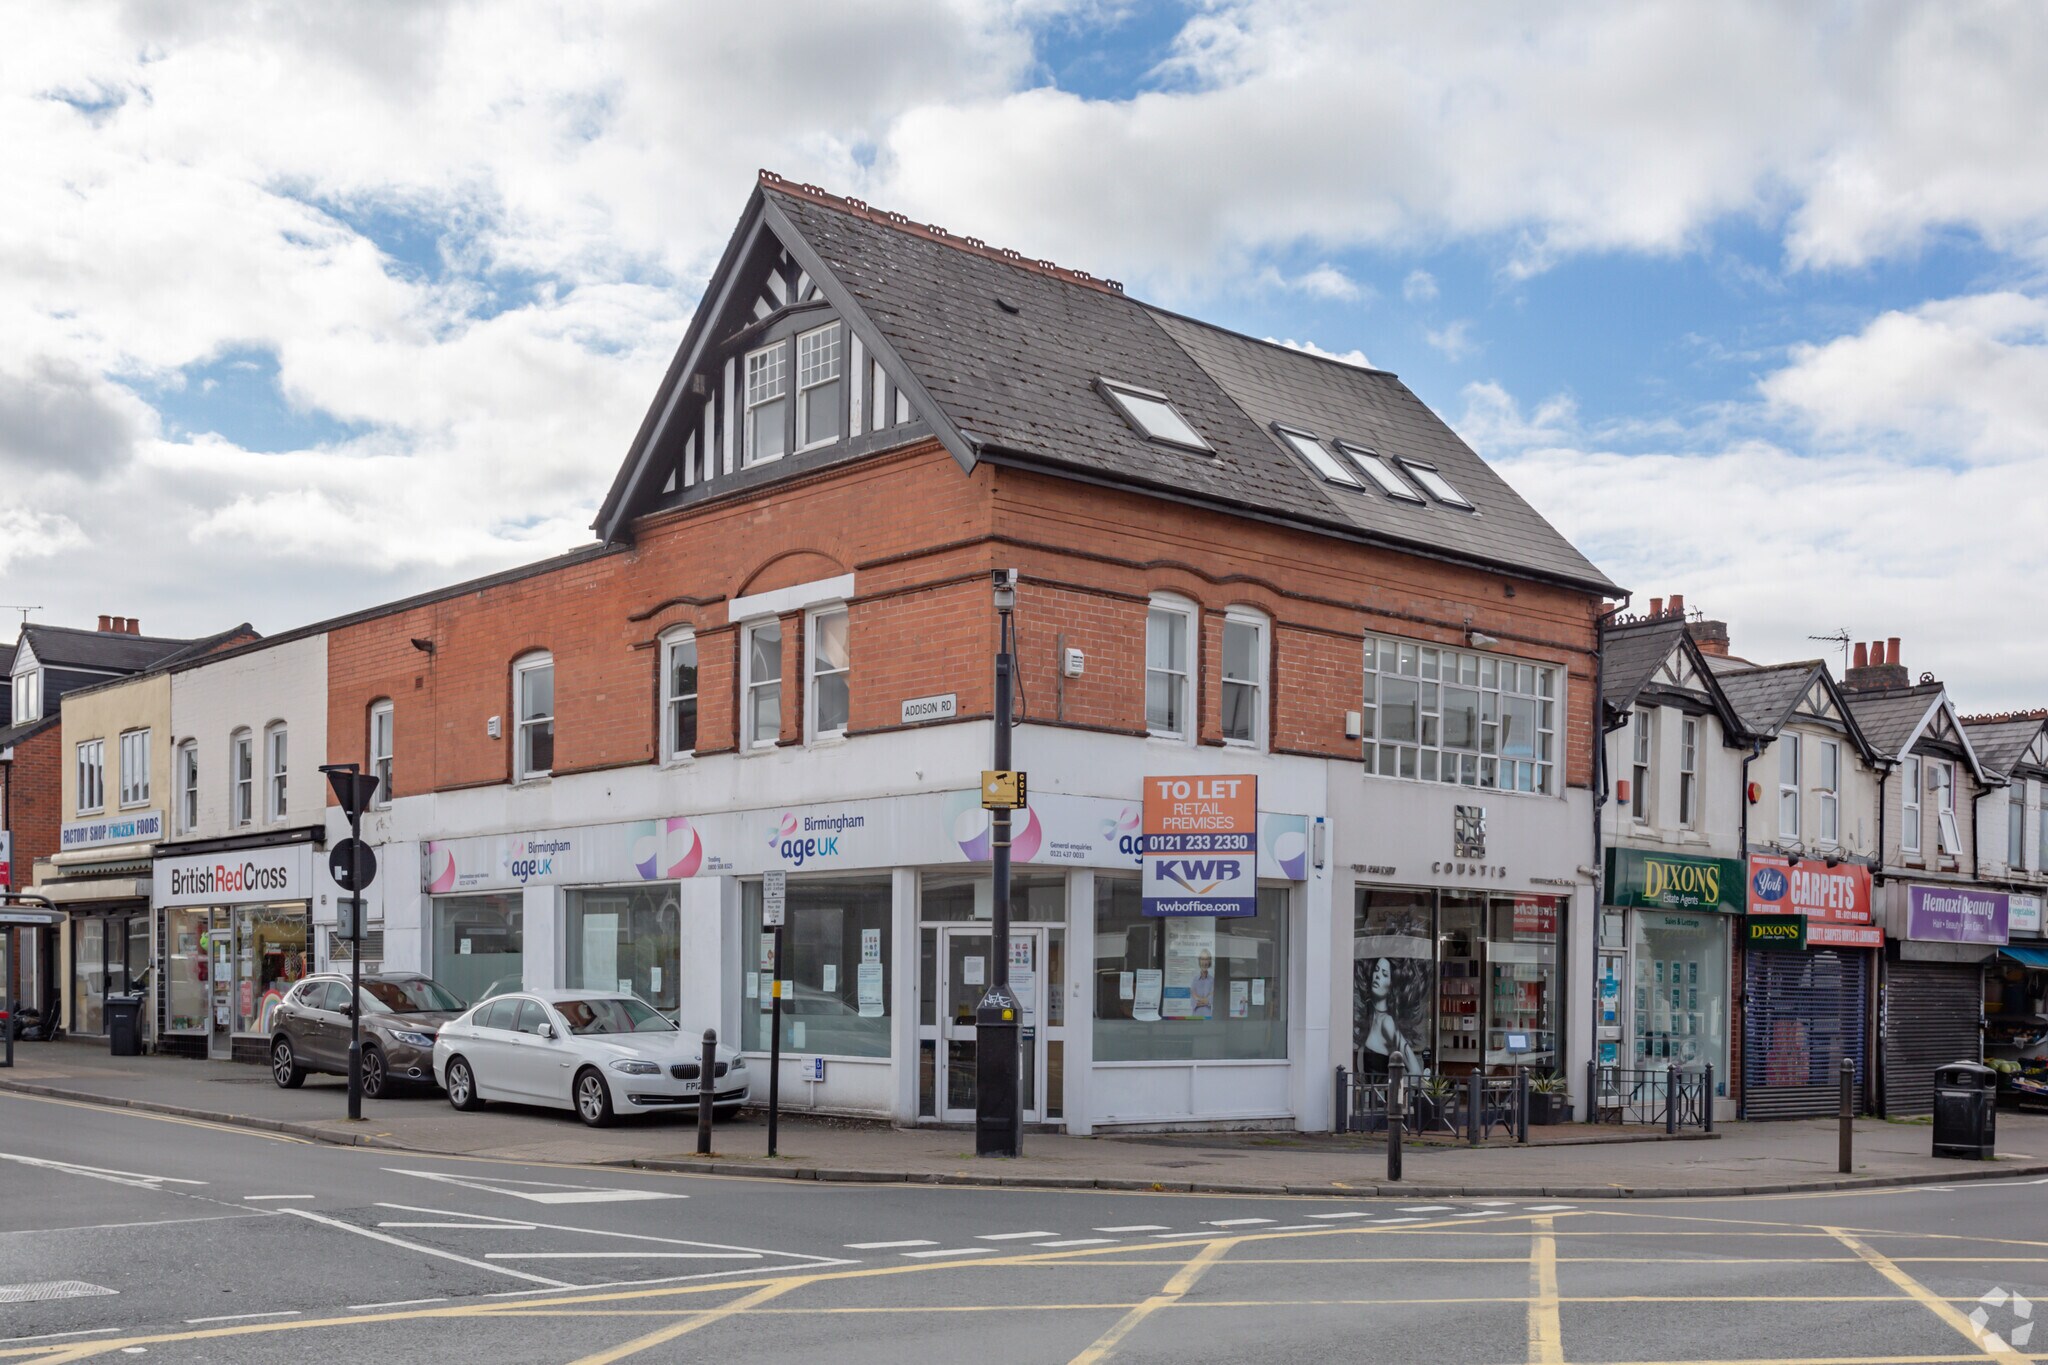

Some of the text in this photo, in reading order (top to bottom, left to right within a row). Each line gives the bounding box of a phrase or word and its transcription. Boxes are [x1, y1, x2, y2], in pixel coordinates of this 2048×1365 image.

[905, 700, 952, 717] ADDISON RD
[1157, 780, 1242, 800] TO LET
[1174, 802, 1223, 815] RETAIL
[63, 827, 88, 844] FACTORY
[90, 825, 106, 840] SHOP
[136, 817, 158, 835] FOODS
[804, 813, 864, 832] Birmingham
[1163, 816, 1234, 830] PREMISES
[528, 839, 571, 856] Birmingham
[1070, 842, 1092, 850] enquiries
[1119, 835, 1143, 864] ag
[1150, 834, 1248, 850] 0121 233 2330
[1156, 860, 1241, 881] KWB
[1432, 862, 1507, 878] COUSTIS
[1644, 860, 1718, 902] DIXONS
[1758, 872, 1782, 896] York
[1790, 870, 1854, 910] CARPETS
[1156, 901, 1240, 912] kwboffice.com
[1664, 892, 1698, 906] Estate Agents
[1922, 893, 1994, 920] Hemaxi Beauty
[1752, 926, 1798, 938] DIXONS
